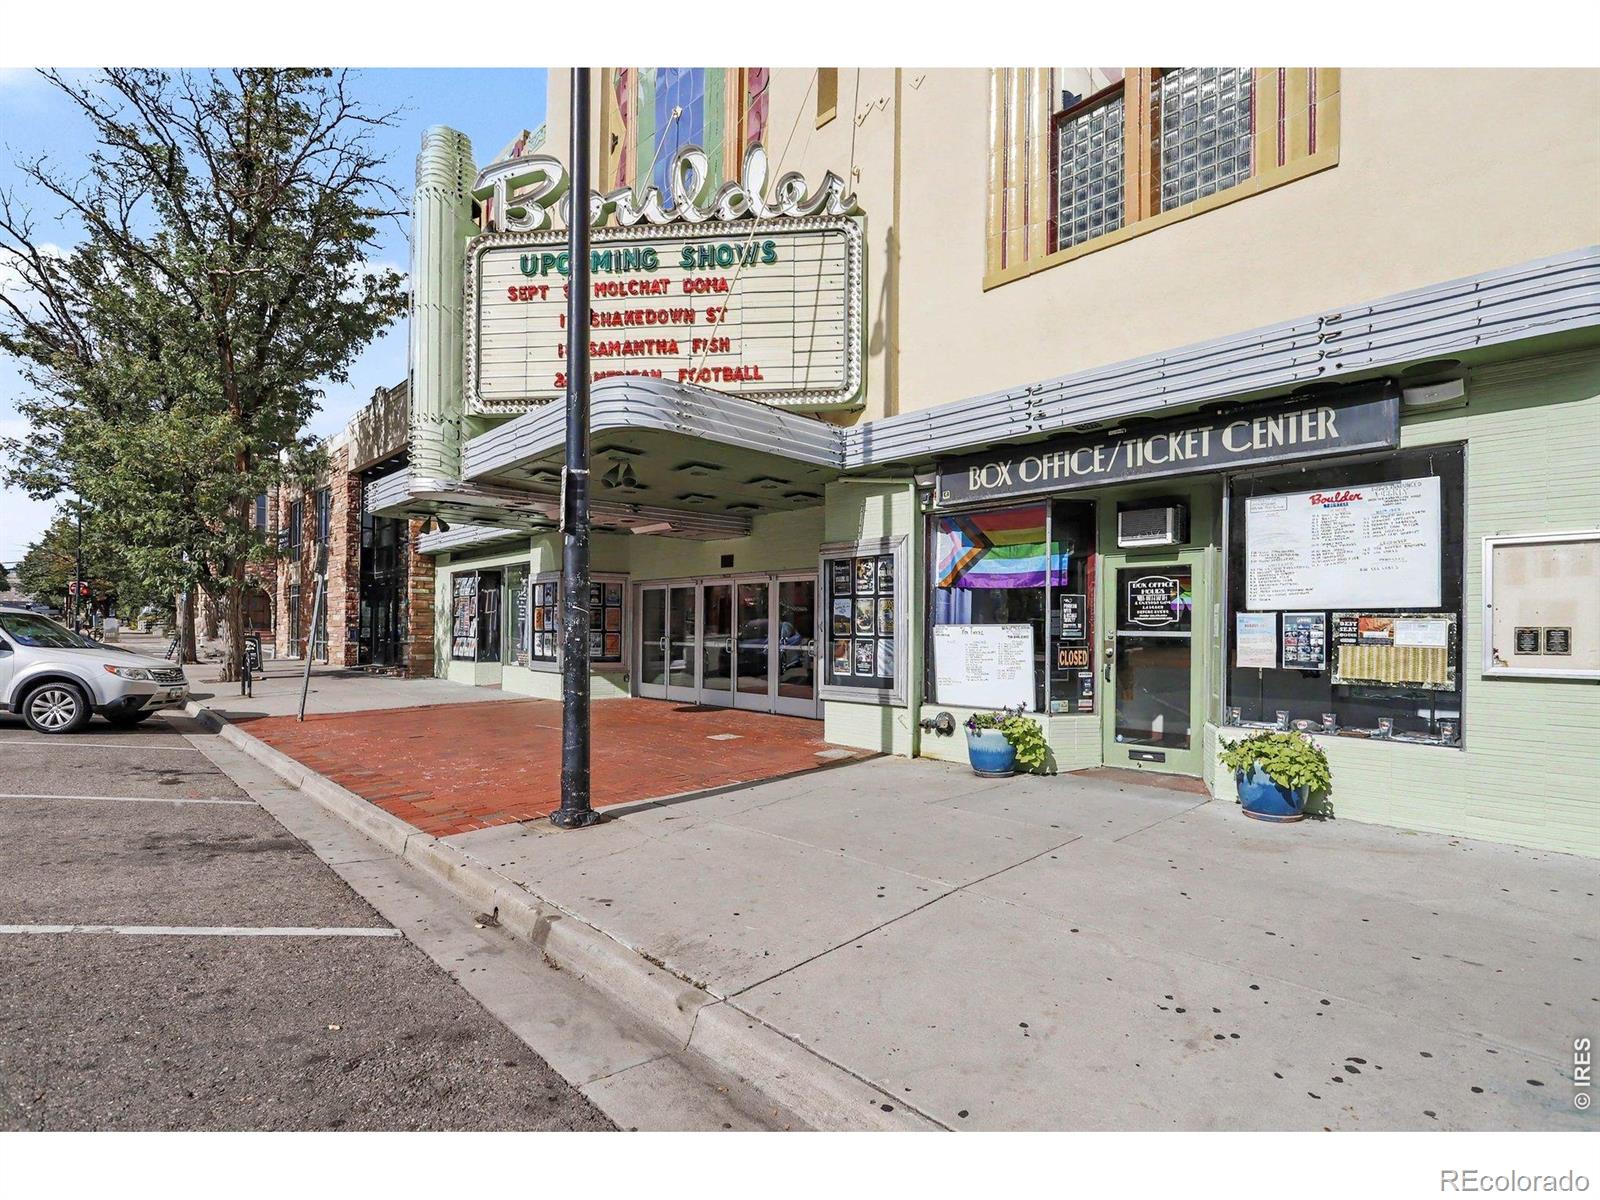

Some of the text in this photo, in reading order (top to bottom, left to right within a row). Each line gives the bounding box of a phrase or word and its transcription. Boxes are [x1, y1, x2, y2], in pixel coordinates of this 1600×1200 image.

[520, 240, 778, 277] UPCMING SHOWS
[508, 284, 550, 301] SEPT
[594, 277, 671, 299] MOLCHAT
[682, 276, 730, 295] DOMA
[591, 307, 696, 329] SHAKEDOWN
[705, 306, 728, 325] ST
[590, 338, 679, 357] SAMANTHA
[692, 337, 731, 354] FISH
[678, 365, 763, 384] FOOTBALL
[969, 406, 1339, 490] BOX OFFICE/TICKET CENTER
[1309, 491, 1363, 505] Boulder
[1060, 650, 1088, 666] CLOSED
